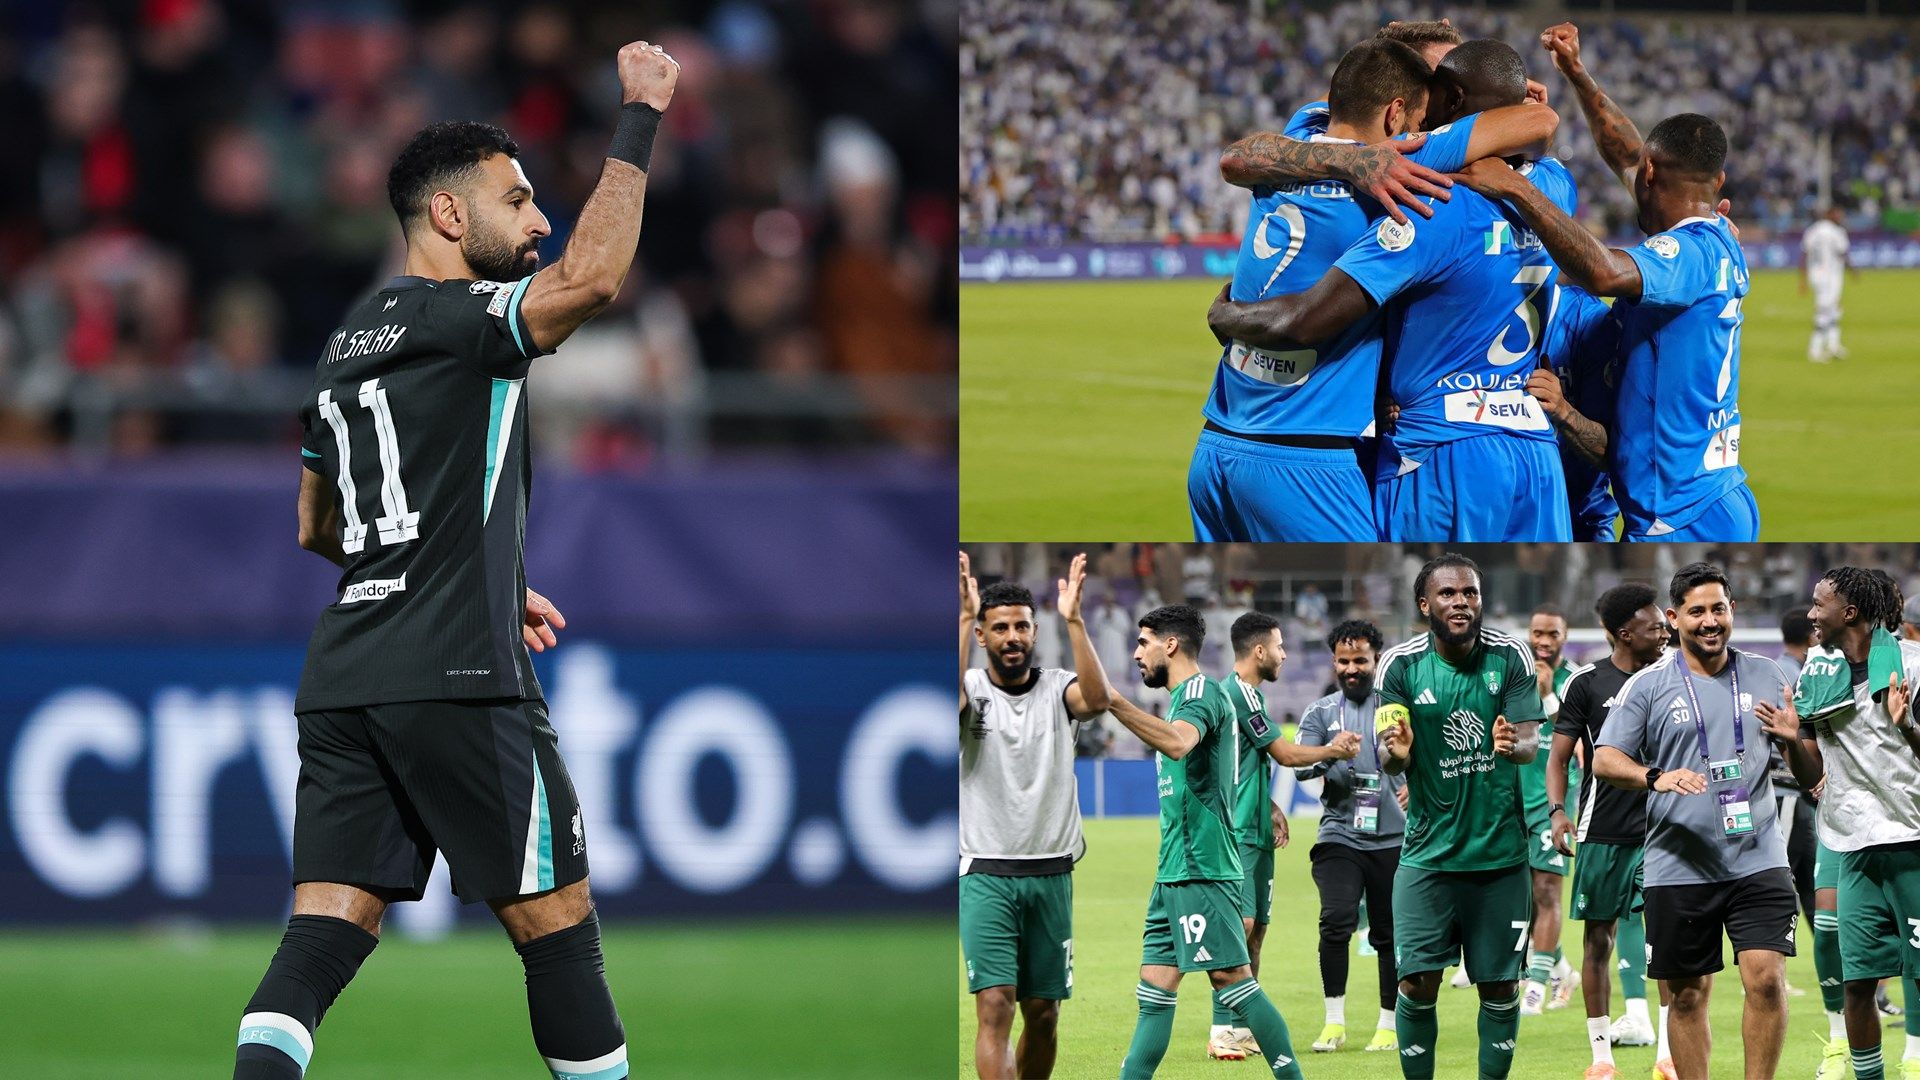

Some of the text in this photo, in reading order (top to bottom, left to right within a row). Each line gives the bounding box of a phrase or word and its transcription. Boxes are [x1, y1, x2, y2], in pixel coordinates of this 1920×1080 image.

[1389, 226, 1402, 240] RSL
[1254, 203, 1306, 299] 9
[1486, 265, 1553, 367] 3
[326, 324, 407, 365] M.SALAH
[1253, 351, 1296, 374] SEVEN
[318, 377, 420, 556] 11
[1672, 709, 1690, 725] SD
[1441, 768, 1459, 779] Red
[1471, 760, 1496, 773] Global
[572, 841, 586, 857] LFC
[1178, 913, 1207, 945] 19
[241, 1029, 273, 1042] LFC
